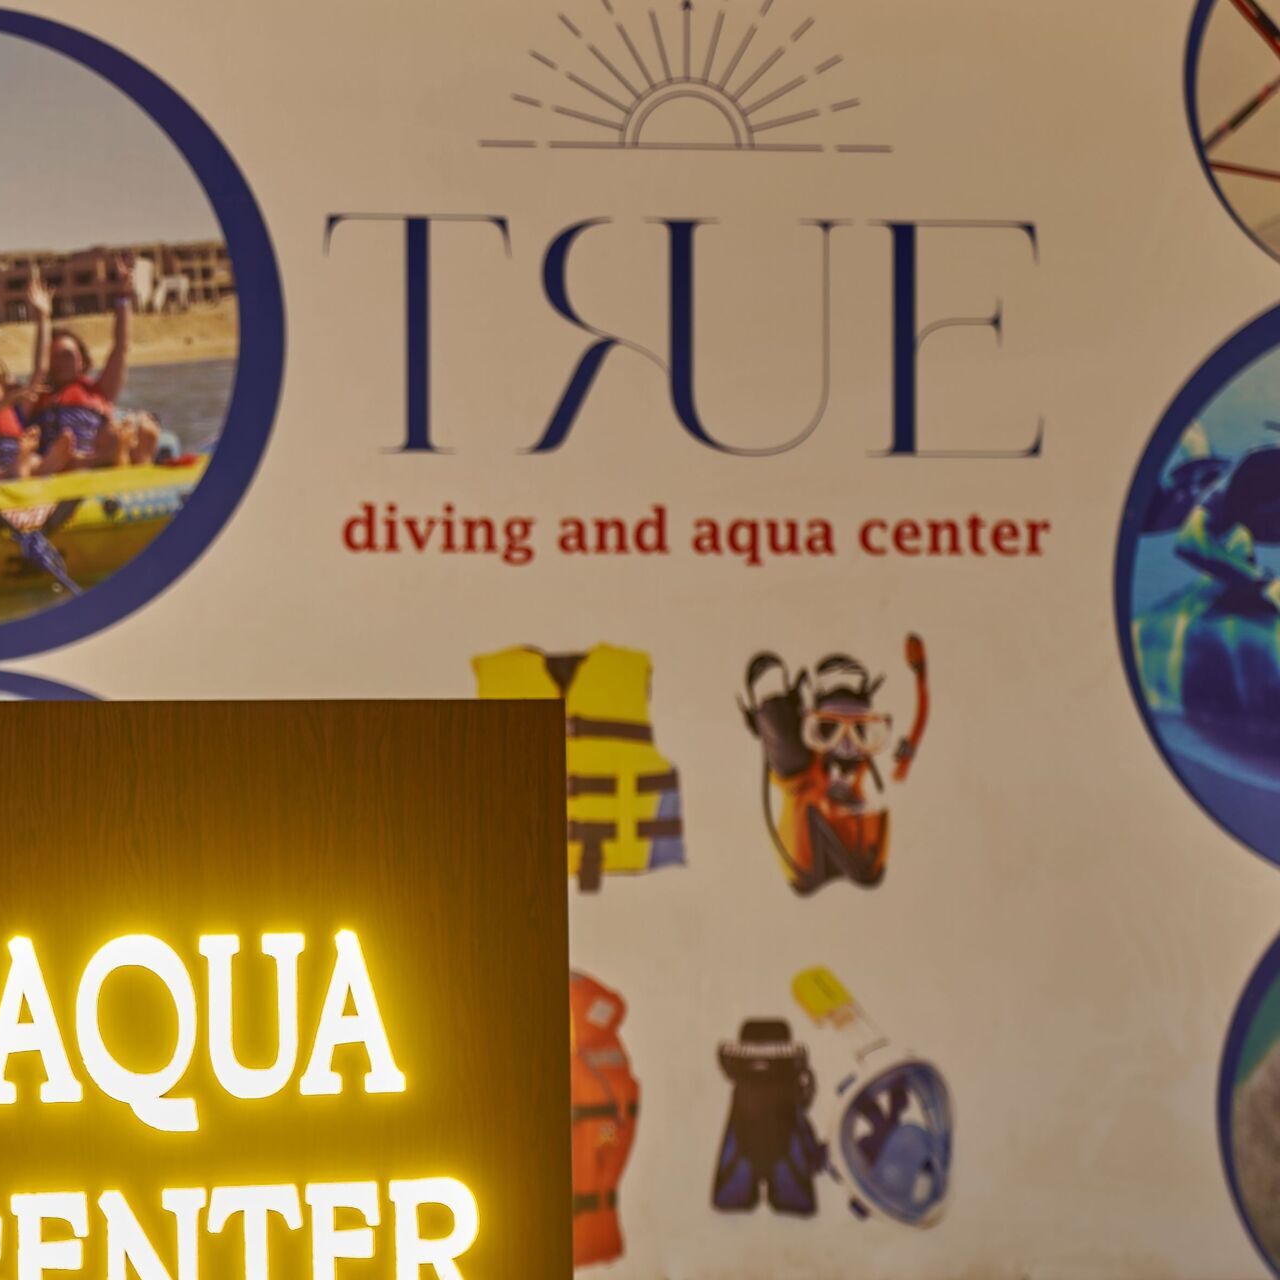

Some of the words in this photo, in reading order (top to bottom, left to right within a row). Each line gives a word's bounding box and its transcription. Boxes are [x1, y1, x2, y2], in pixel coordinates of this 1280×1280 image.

[322, 211, 1046, 460] TRUE
[341, 502, 536, 565] diving
[556, 503, 669, 557] and
[691, 514, 838, 567] aqua
[859, 511, 1052, 558] center
